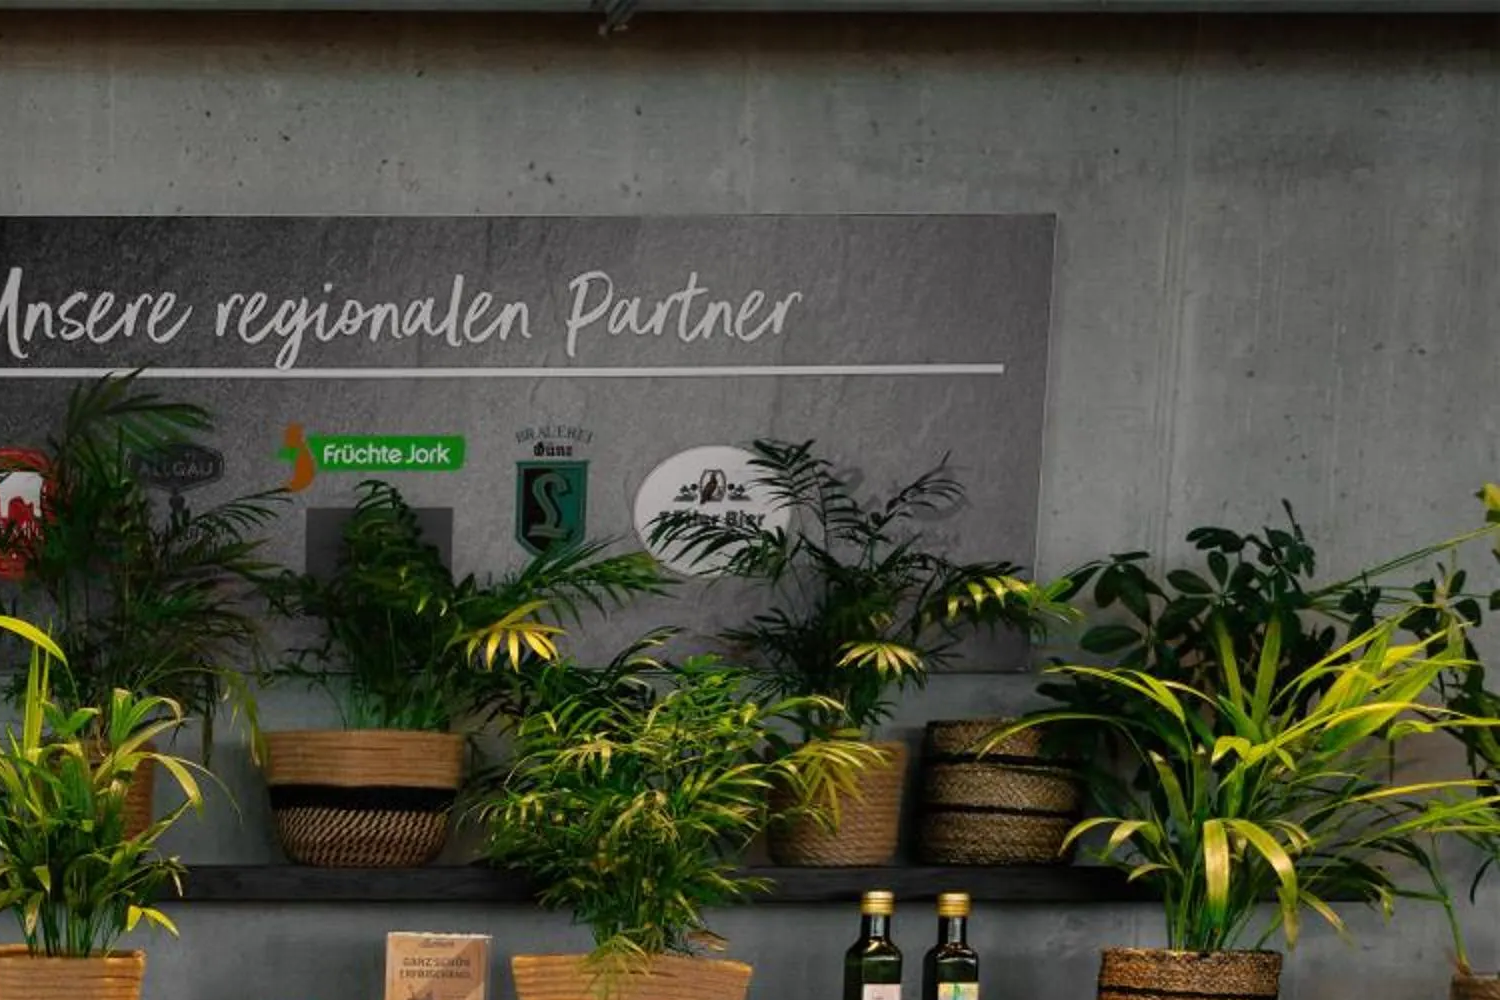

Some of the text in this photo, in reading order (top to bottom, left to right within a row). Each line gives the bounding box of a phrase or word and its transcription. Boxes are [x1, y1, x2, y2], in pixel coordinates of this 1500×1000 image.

[215, 273, 532, 371] regionalen
[565, 270, 802, 357] Partner
[323, 442, 451, 465] Früchte Jork
